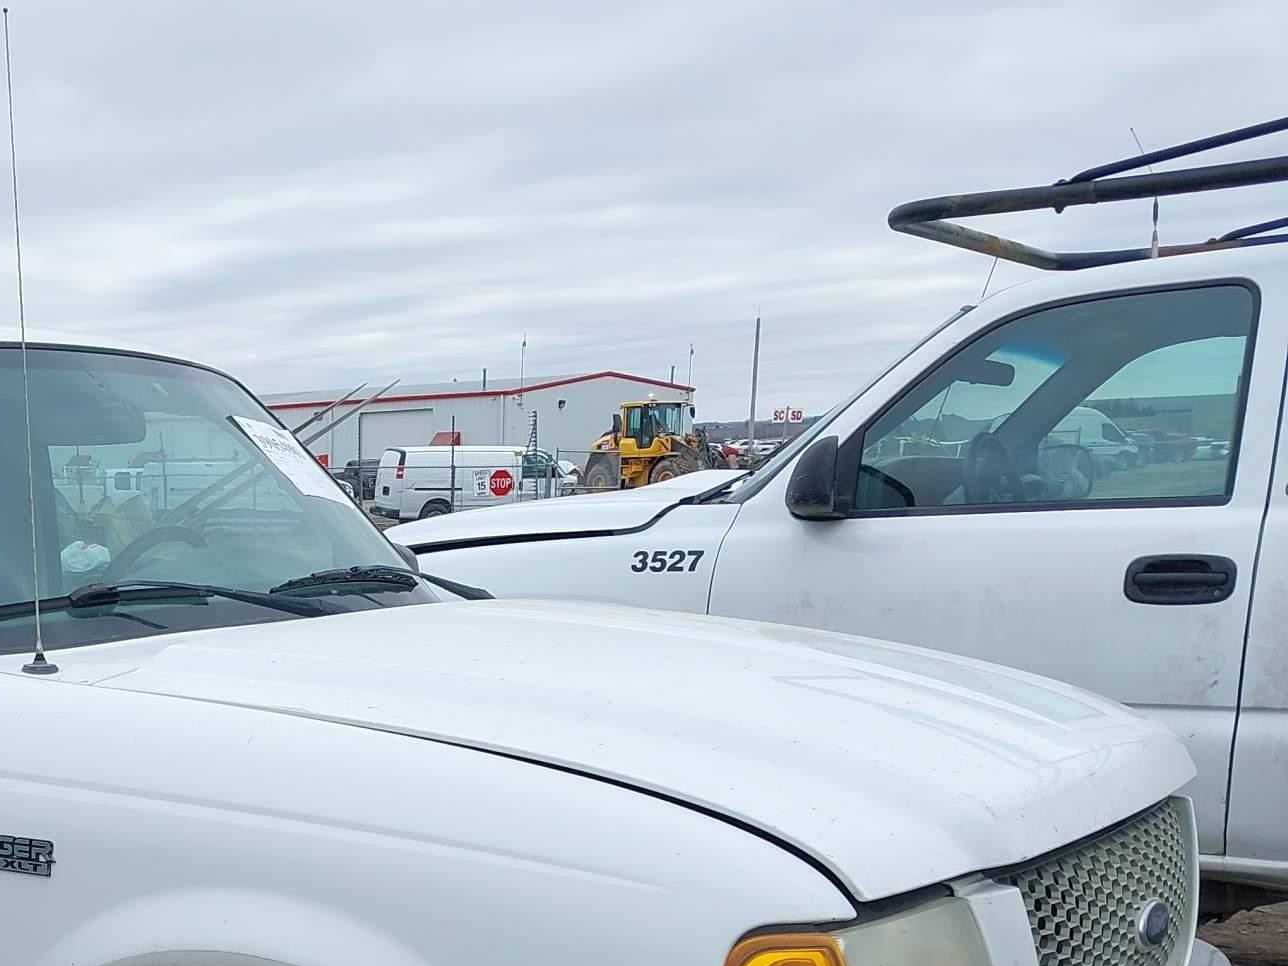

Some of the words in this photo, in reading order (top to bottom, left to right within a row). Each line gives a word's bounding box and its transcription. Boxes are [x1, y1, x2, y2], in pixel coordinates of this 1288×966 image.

[773, 410, 785, 421] SC
[791, 410, 802, 421] SD
[477, 481, 487, 491] 15
[490, 477, 512, 489] STOP
[631, 550, 705, 572] 3527
[2, 859, 43, 873] XLT
